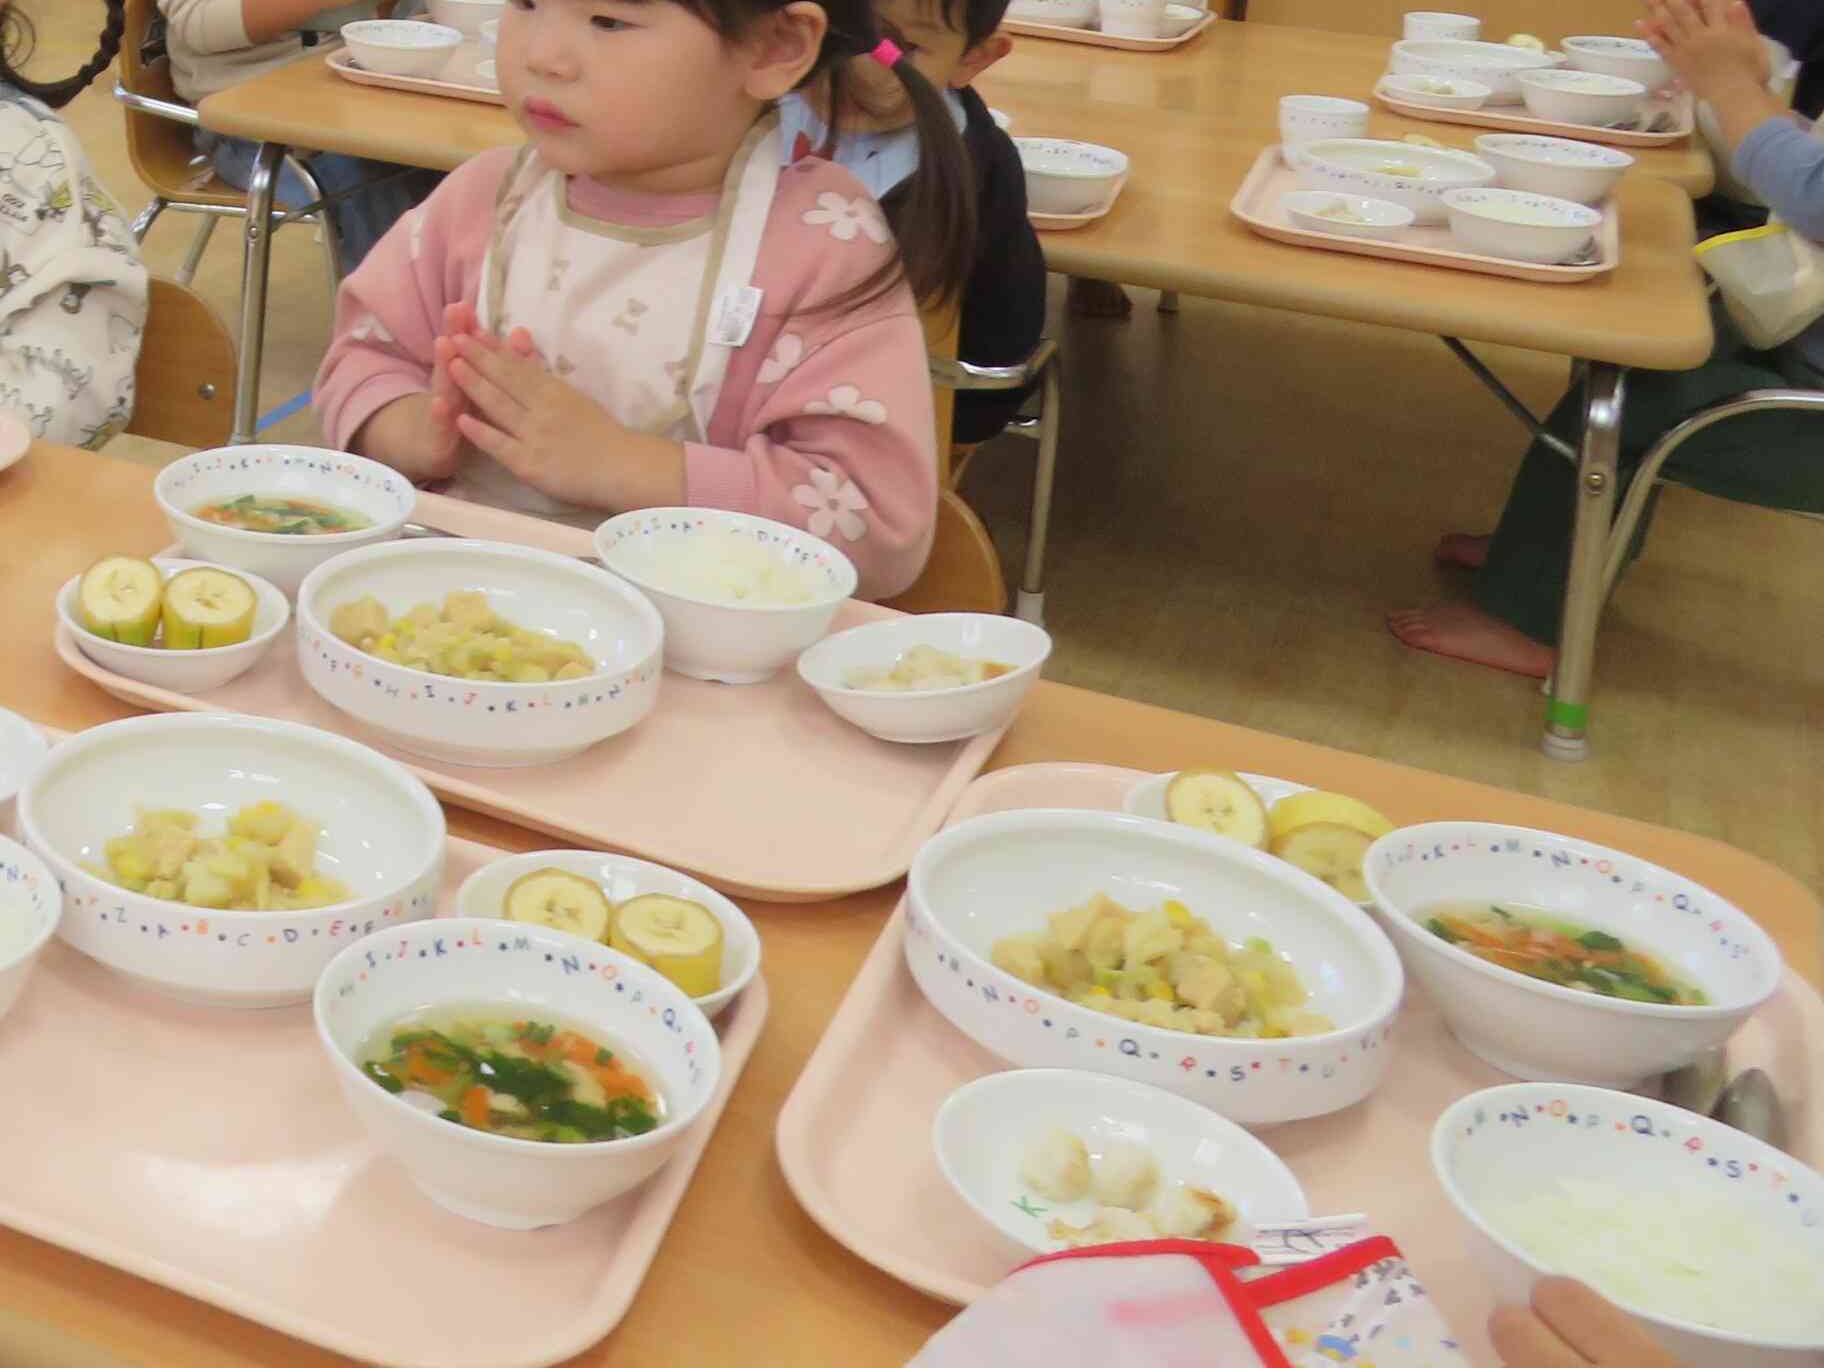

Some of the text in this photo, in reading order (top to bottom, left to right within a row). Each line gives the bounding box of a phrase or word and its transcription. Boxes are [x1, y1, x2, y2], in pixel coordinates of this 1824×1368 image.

[237, 933, 251, 947] C
[329, 919, 344, 936] E
[513, 936, 530, 951] M
[560, 955, 581, 976] N
[1119, 1038, 1142, 1057] Q
[1230, 1065, 1247, 1081] S
[1631, 1115, 1655, 1135] Q
[1727, 1160, 1742, 1178] S
